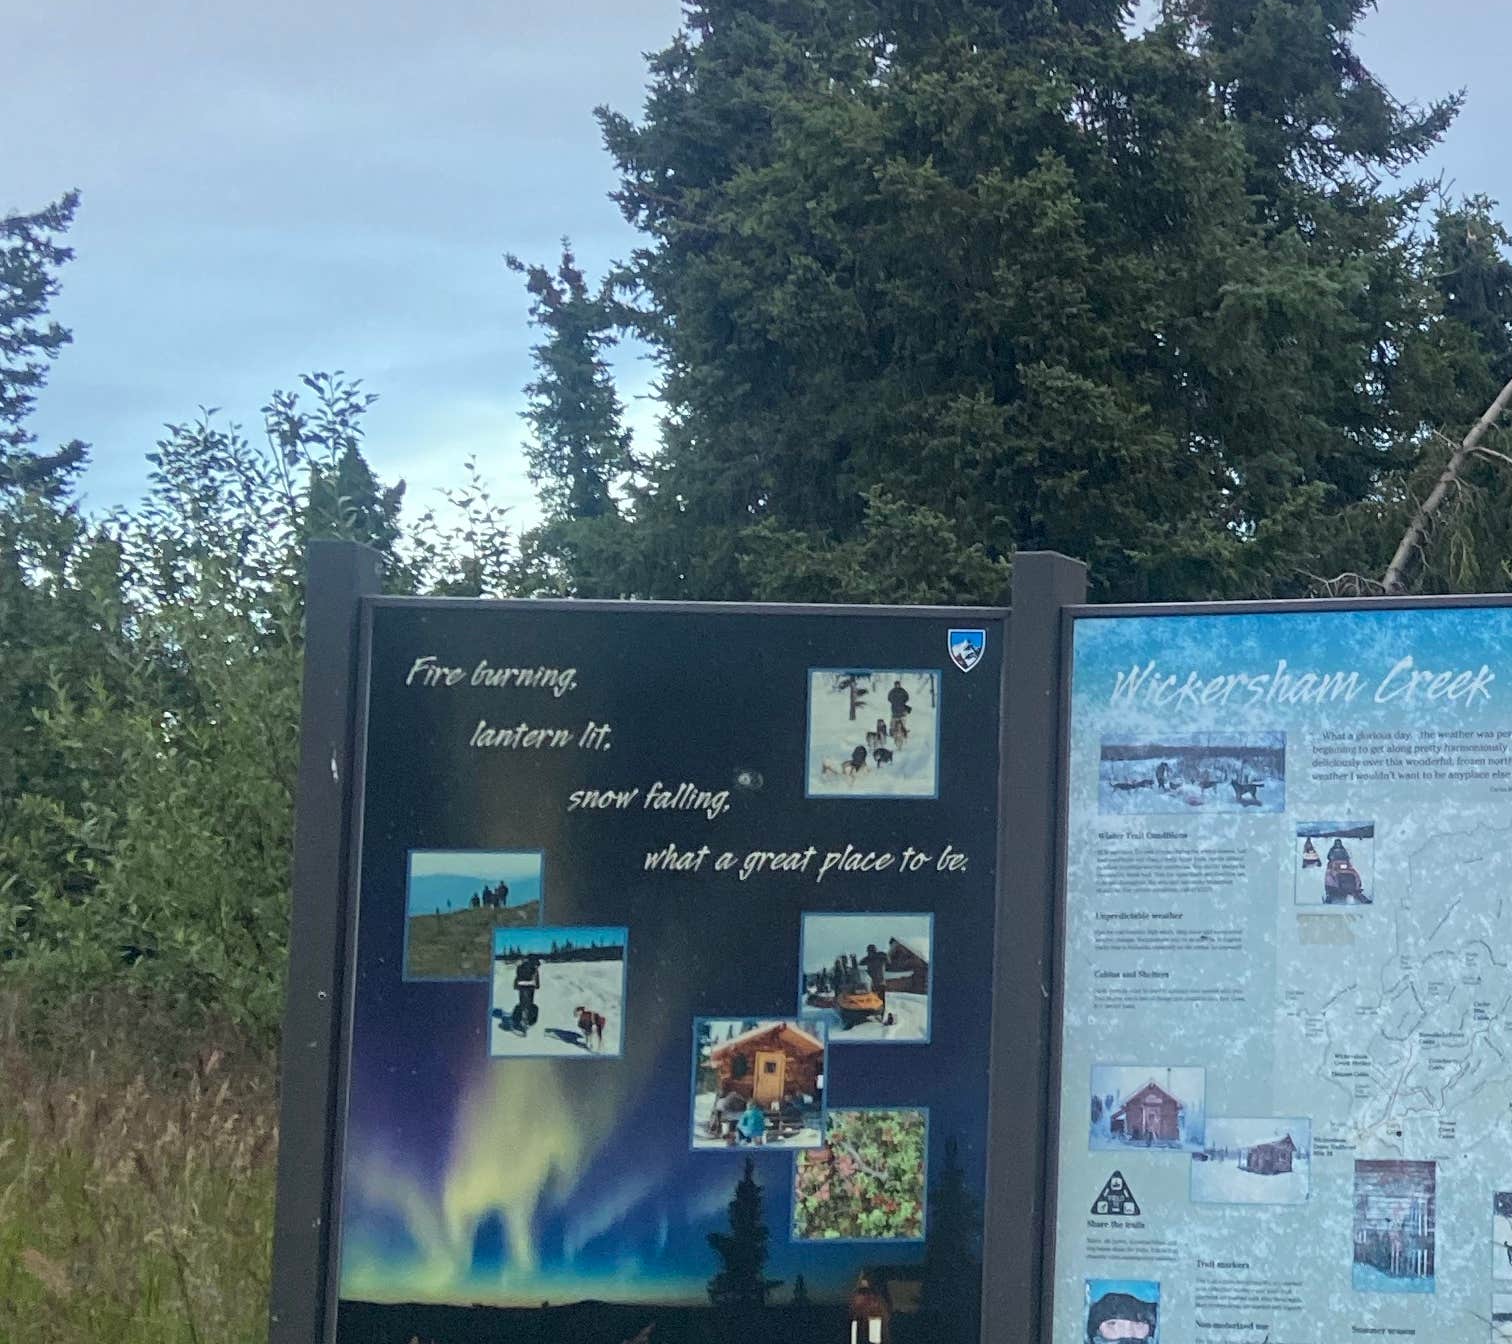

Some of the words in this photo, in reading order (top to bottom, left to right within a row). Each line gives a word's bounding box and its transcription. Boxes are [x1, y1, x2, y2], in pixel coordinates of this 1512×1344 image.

[406, 656, 466, 687] Fire
[1109, 658, 1370, 709] Wickersham
[1374, 654, 1496, 706] Creek
[469, 719, 574, 750] lantern
[1437, 729, 1474, 739] weather
[1312, 745, 1356, 755] beginning
[1358, 745, 1368, 753] to
[1370, 745, 1384, 754] get
[1387, 744, 1412, 754] along
[1414, 744, 1441, 754] pretty
[1312, 758, 1360, 768] deliciously
[1386, 758, 1403, 766] this
[1312, 772, 1348, 780] weather
[1422, 771, 1433, 779] to
[1435, 770, 1446, 779] be
[1492, 770, 1511, 778] else
[568, 788, 638, 811] snow
[643, 843, 711, 873] what
[714, 854, 738, 871] a
[738, 846, 817, 881] great
[815, 844, 896, 883] place
[899, 846, 932, 873] to
[936, 845, 968, 872] be.
